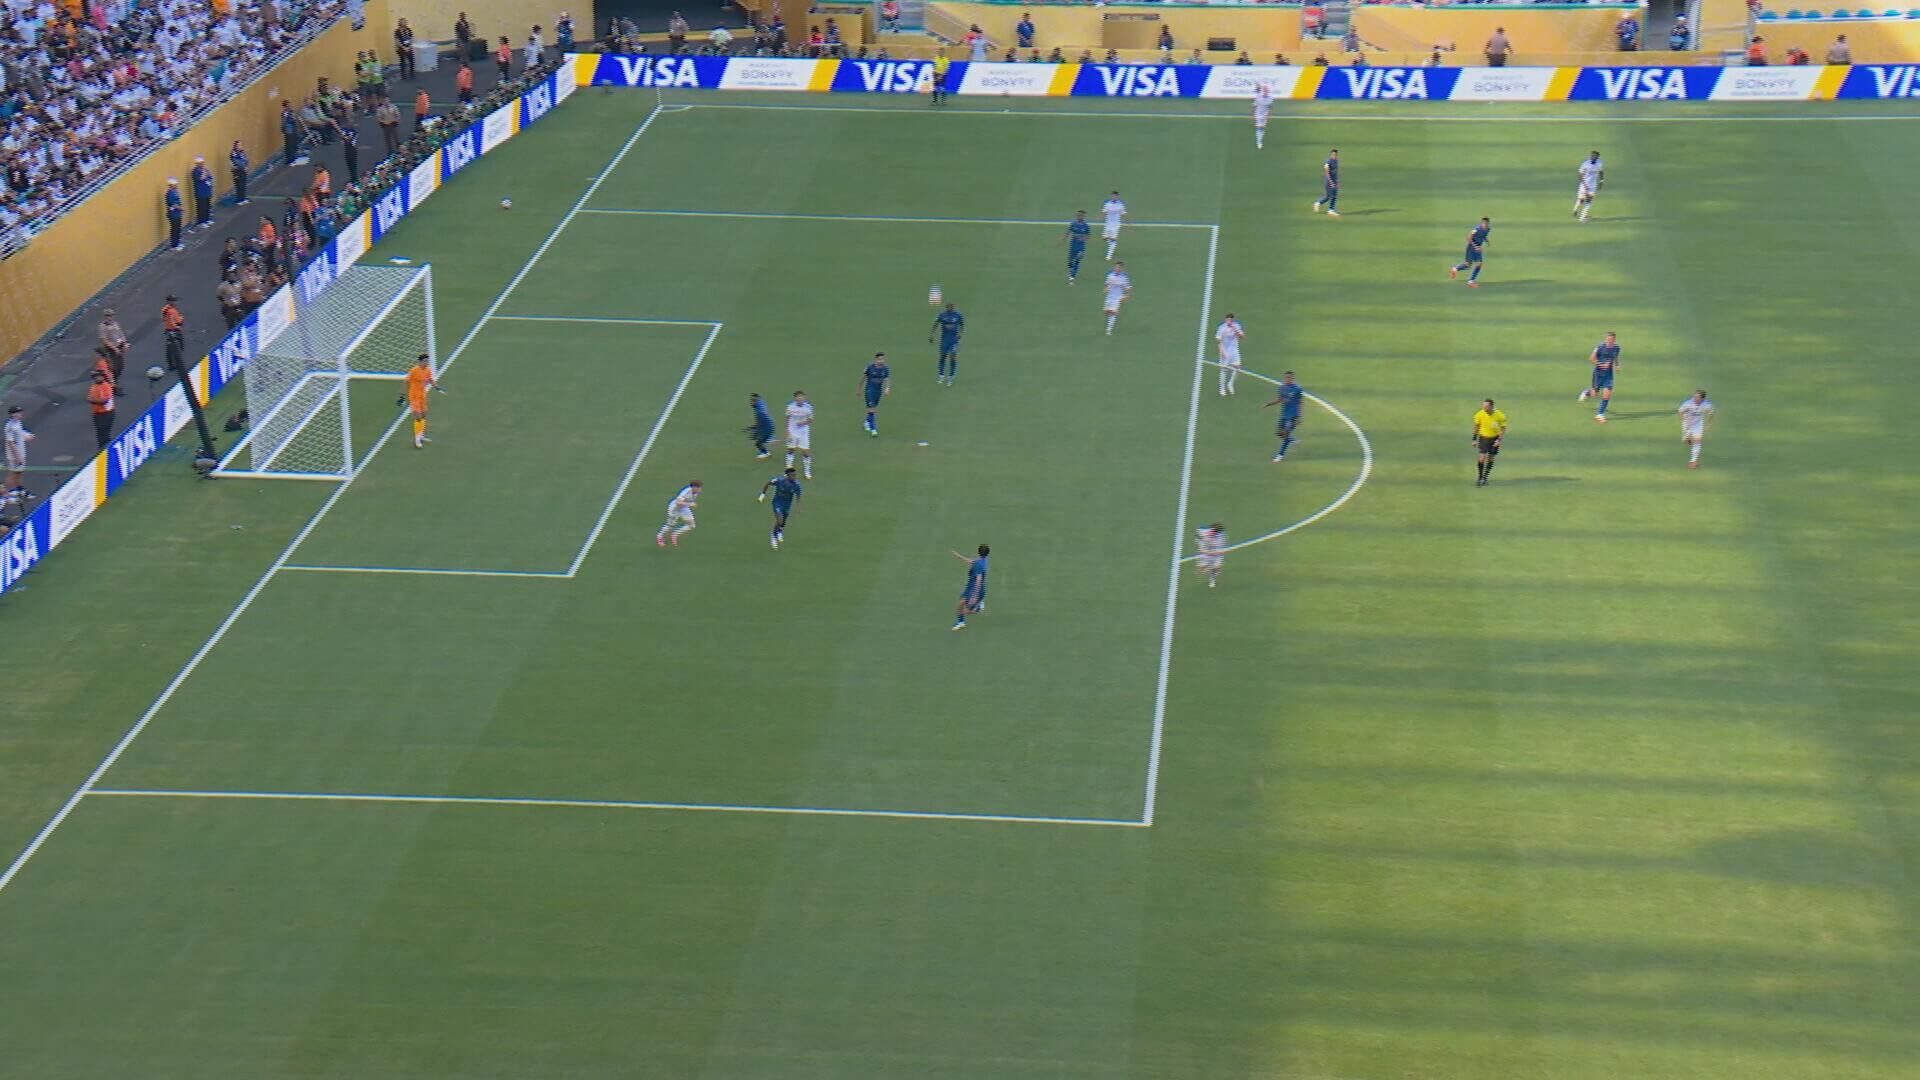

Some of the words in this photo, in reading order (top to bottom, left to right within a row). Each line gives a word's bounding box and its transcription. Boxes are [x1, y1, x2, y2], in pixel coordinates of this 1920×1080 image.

[614, 57, 700, 86] VISA
[852, 61, 934, 91] VISA
[1094, 66, 1180, 96] VISA
[1338, 68, 1428, 98] VISA
[1594, 68, 1687, 98] VISA
[525, 81, 553, 121] VISA
[444, 130, 477, 172] VISA
[374, 185, 404, 233] VISA
[213, 326, 252, 383] VISA
[112, 413, 156, 480] VISA
